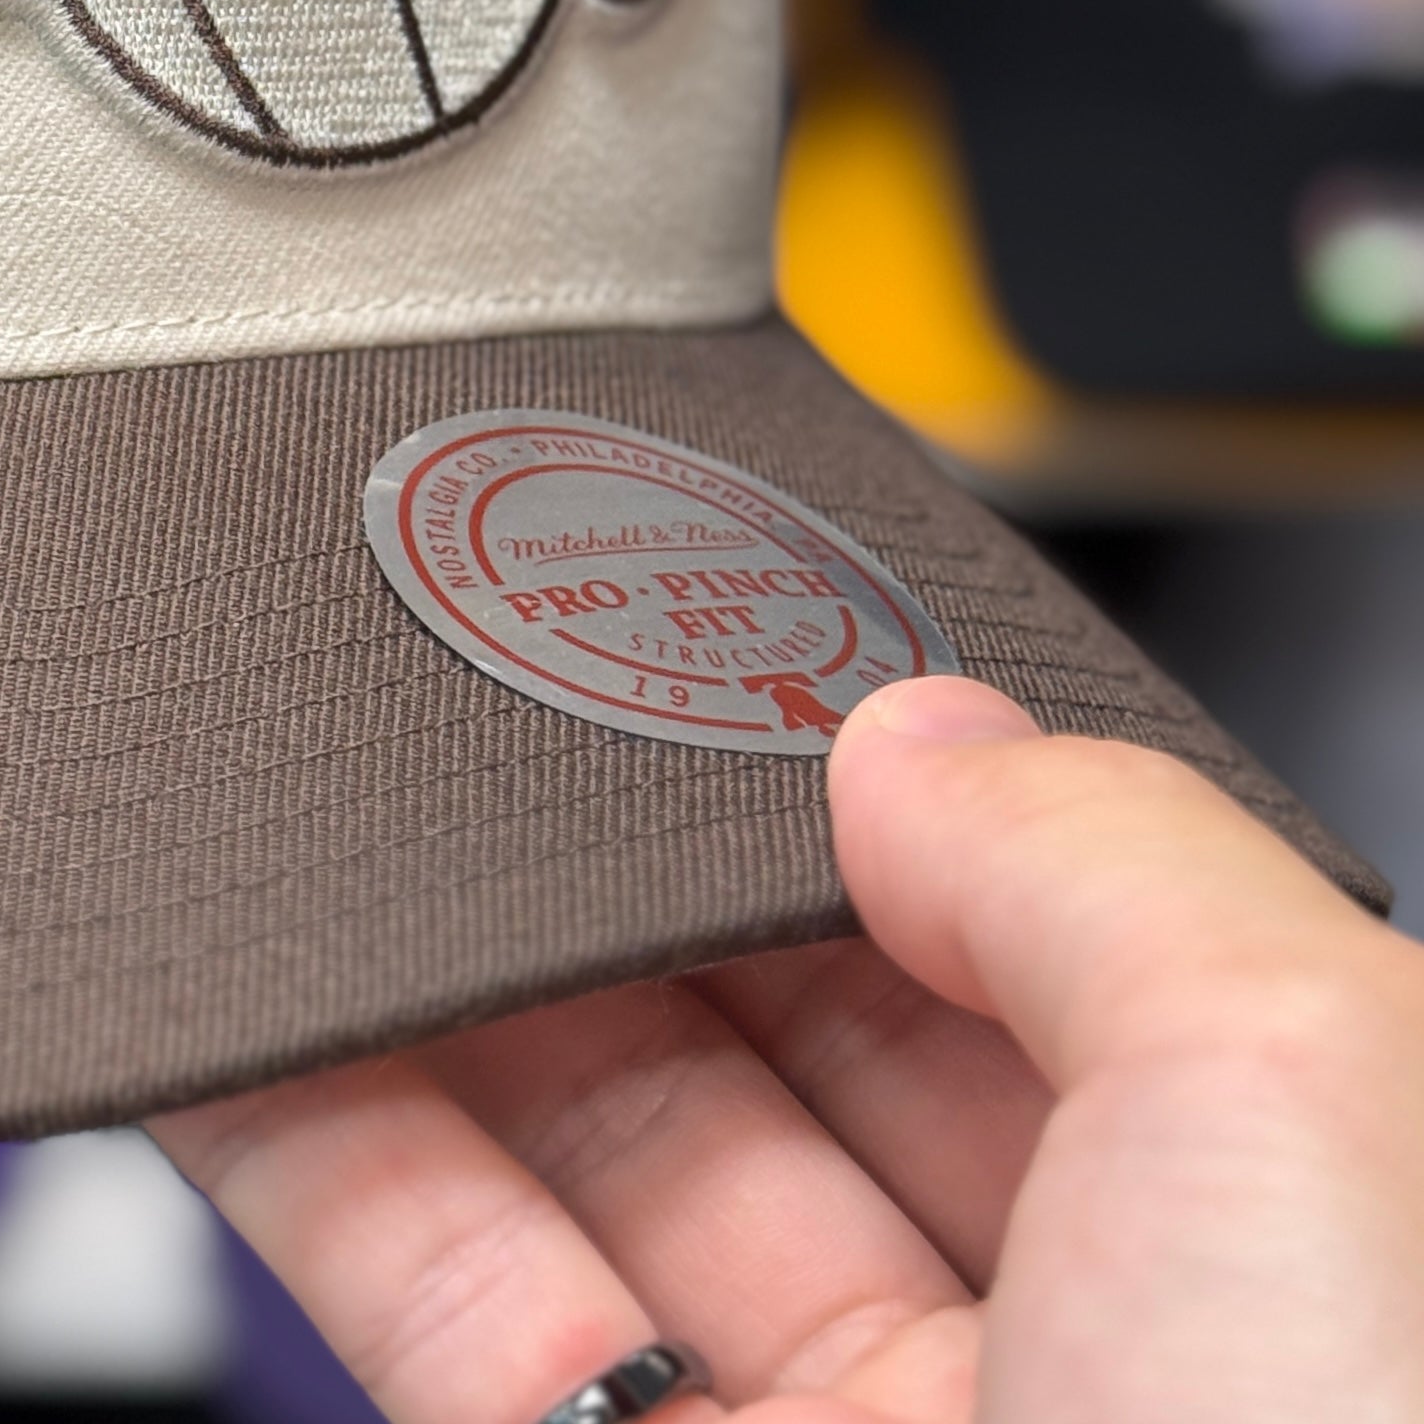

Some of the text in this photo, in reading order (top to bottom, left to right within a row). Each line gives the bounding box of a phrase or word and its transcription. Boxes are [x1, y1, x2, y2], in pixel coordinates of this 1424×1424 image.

[425, 475, 480, 590] NOSTALGIA
[497, 521, 760, 561] Mitchell & Ness
[650, 569, 849, 601] PINCH
[663, 605, 766, 640] FIT
[629, 619, 827, 669] STRUCTURED
[629, 676, 692, 708] 19
